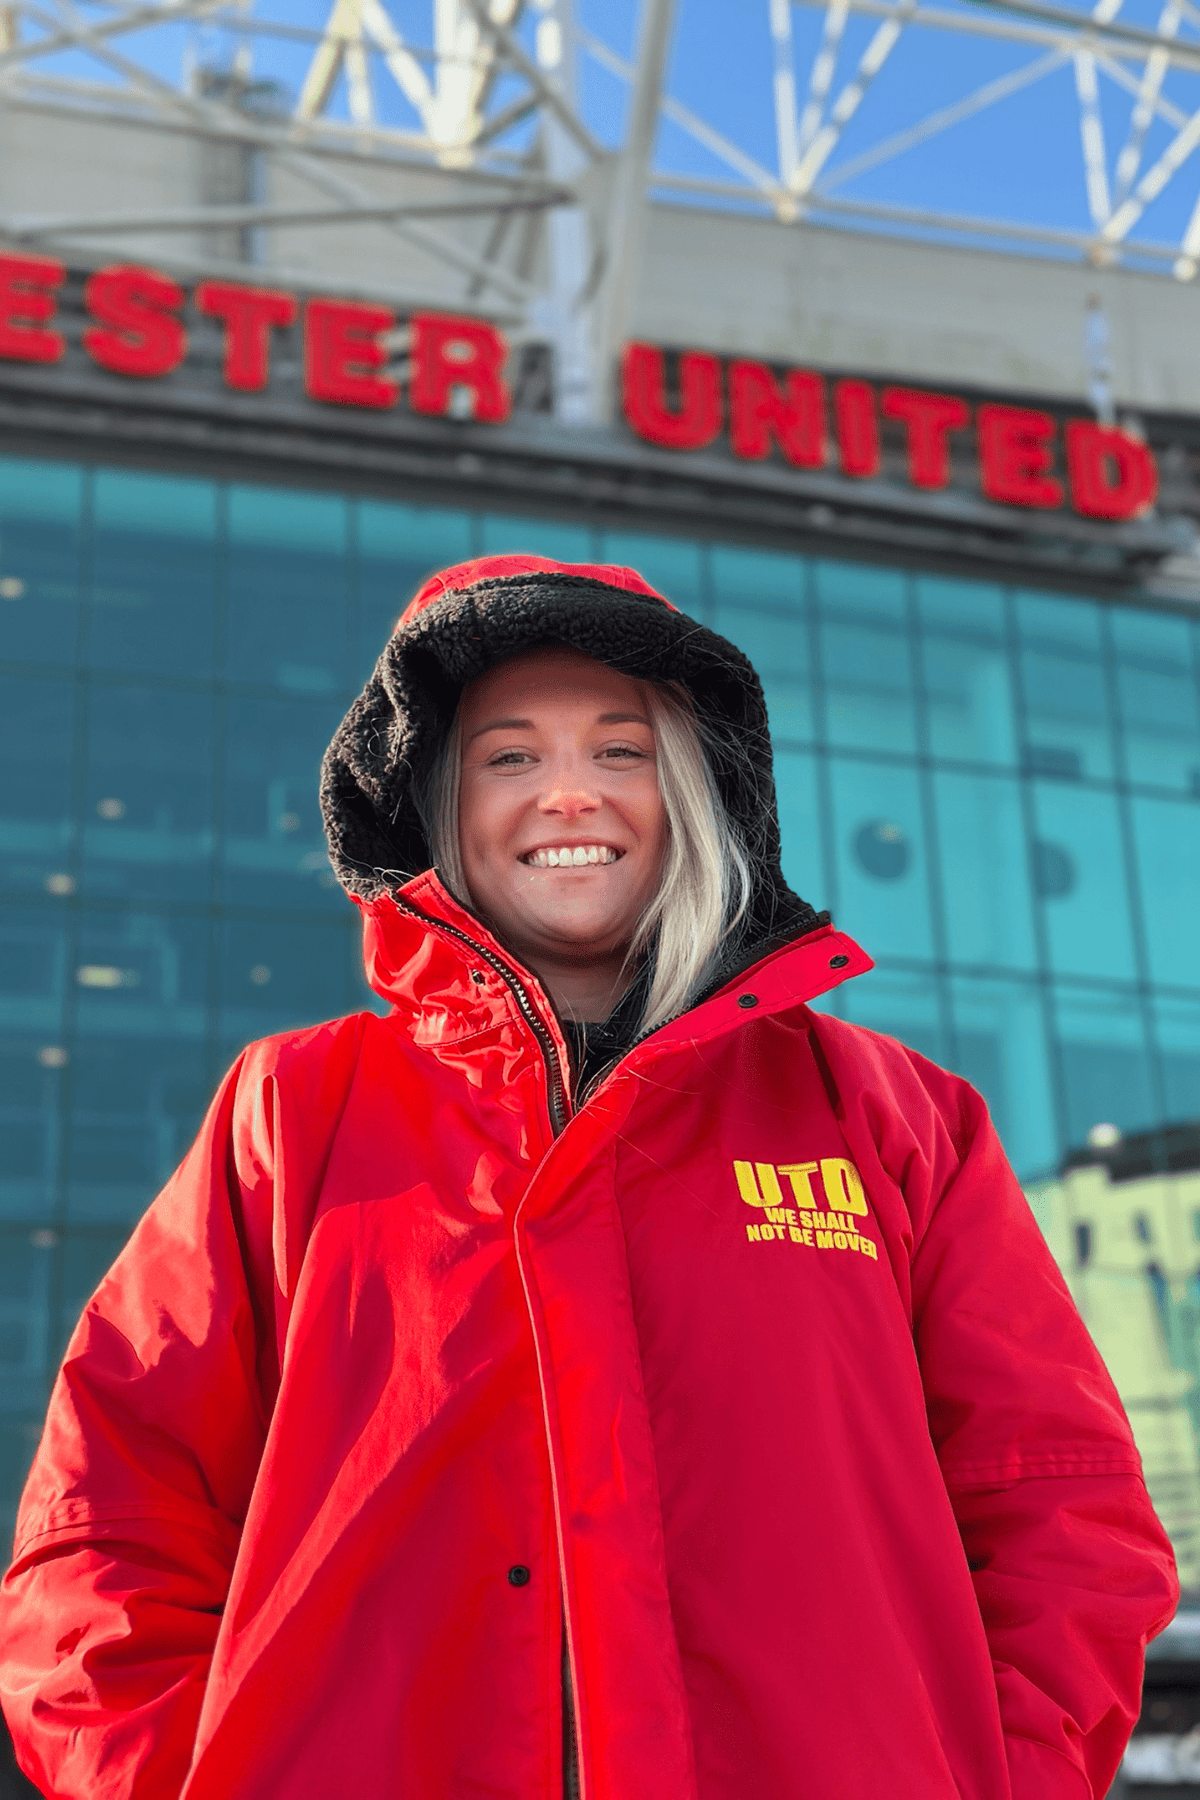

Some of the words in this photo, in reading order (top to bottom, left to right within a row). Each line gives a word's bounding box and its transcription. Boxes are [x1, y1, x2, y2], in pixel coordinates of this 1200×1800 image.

[0, 253, 511, 423] ESTER
[621, 340, 1160, 521] UNITED
[733, 1158, 868, 1217] UTD
[746, 1223, 785, 1242] NOT
[789, 1226, 815, 1247] BE
[815, 1230, 878, 1261] MOVED
[764, 1207, 798, 1225] WE
[799, 1210, 859, 1233] SHALL
